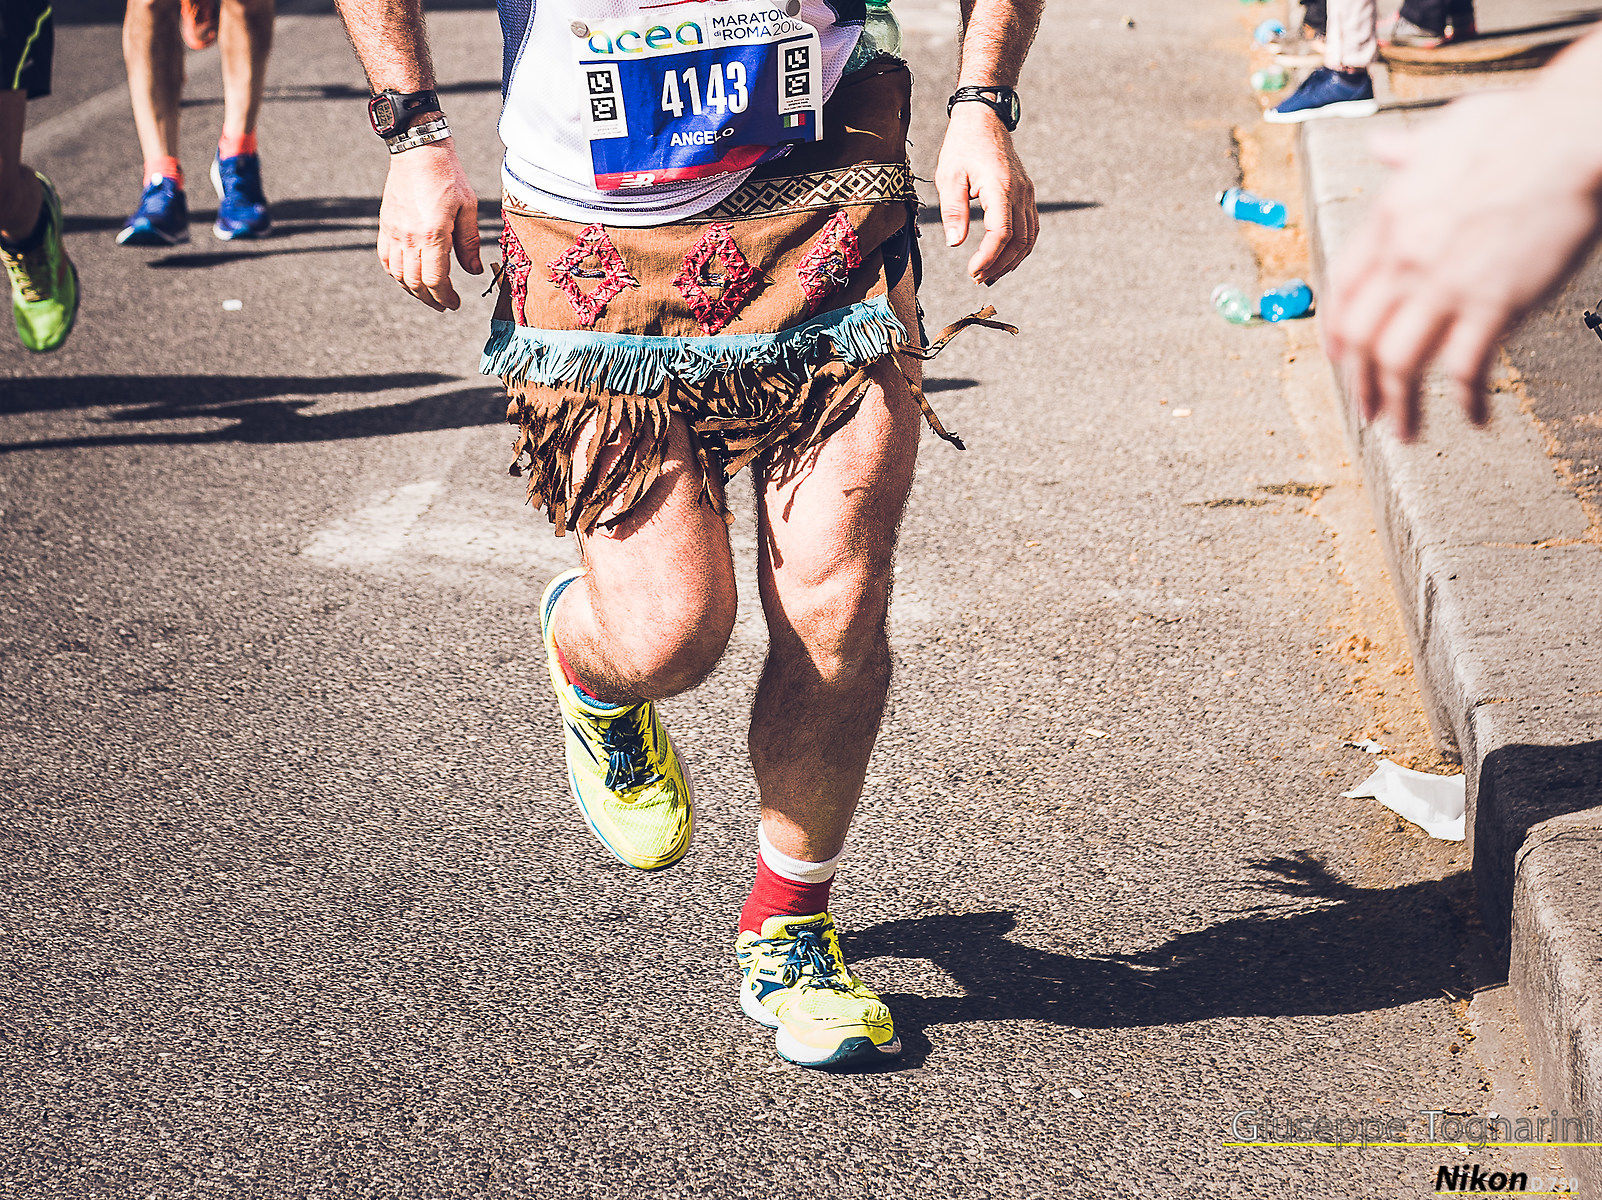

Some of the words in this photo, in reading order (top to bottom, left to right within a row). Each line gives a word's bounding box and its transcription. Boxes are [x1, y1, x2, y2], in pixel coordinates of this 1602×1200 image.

[588, 21, 704, 54] acea
[722, 25, 772, 41] ROMA
[661, 61, 749, 117] 4143
[670, 127, 735, 147] ANGELO
